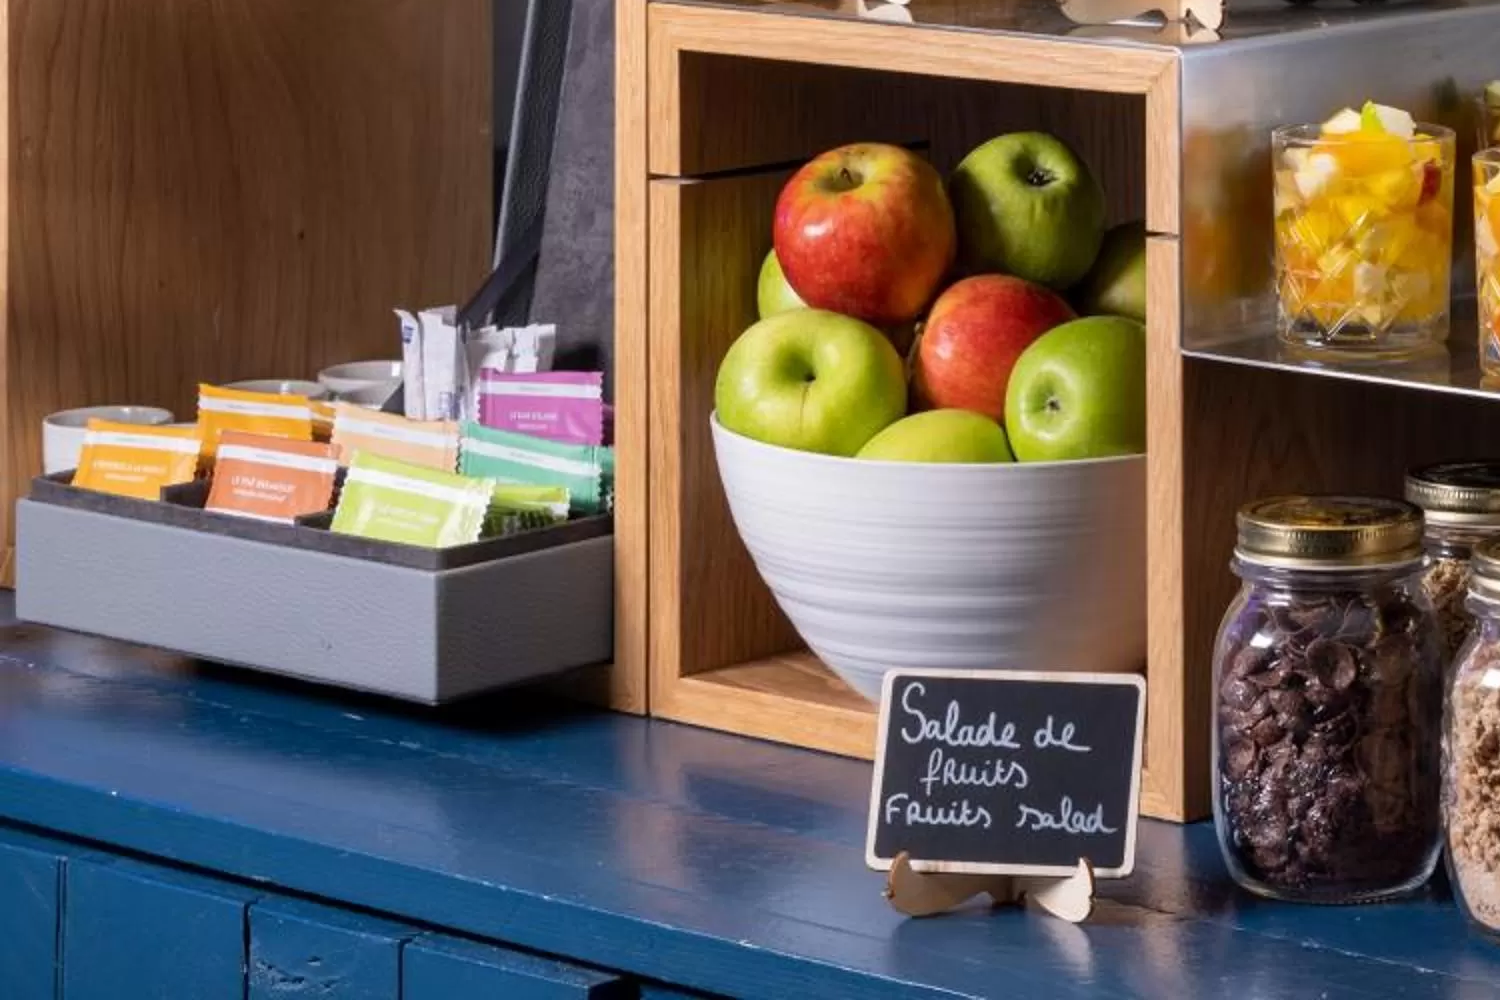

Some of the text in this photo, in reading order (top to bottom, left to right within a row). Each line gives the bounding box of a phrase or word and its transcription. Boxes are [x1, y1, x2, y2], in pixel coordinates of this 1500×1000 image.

[901, 681, 1092, 751] Salade de
[1015, 796, 1118, 834] salad
